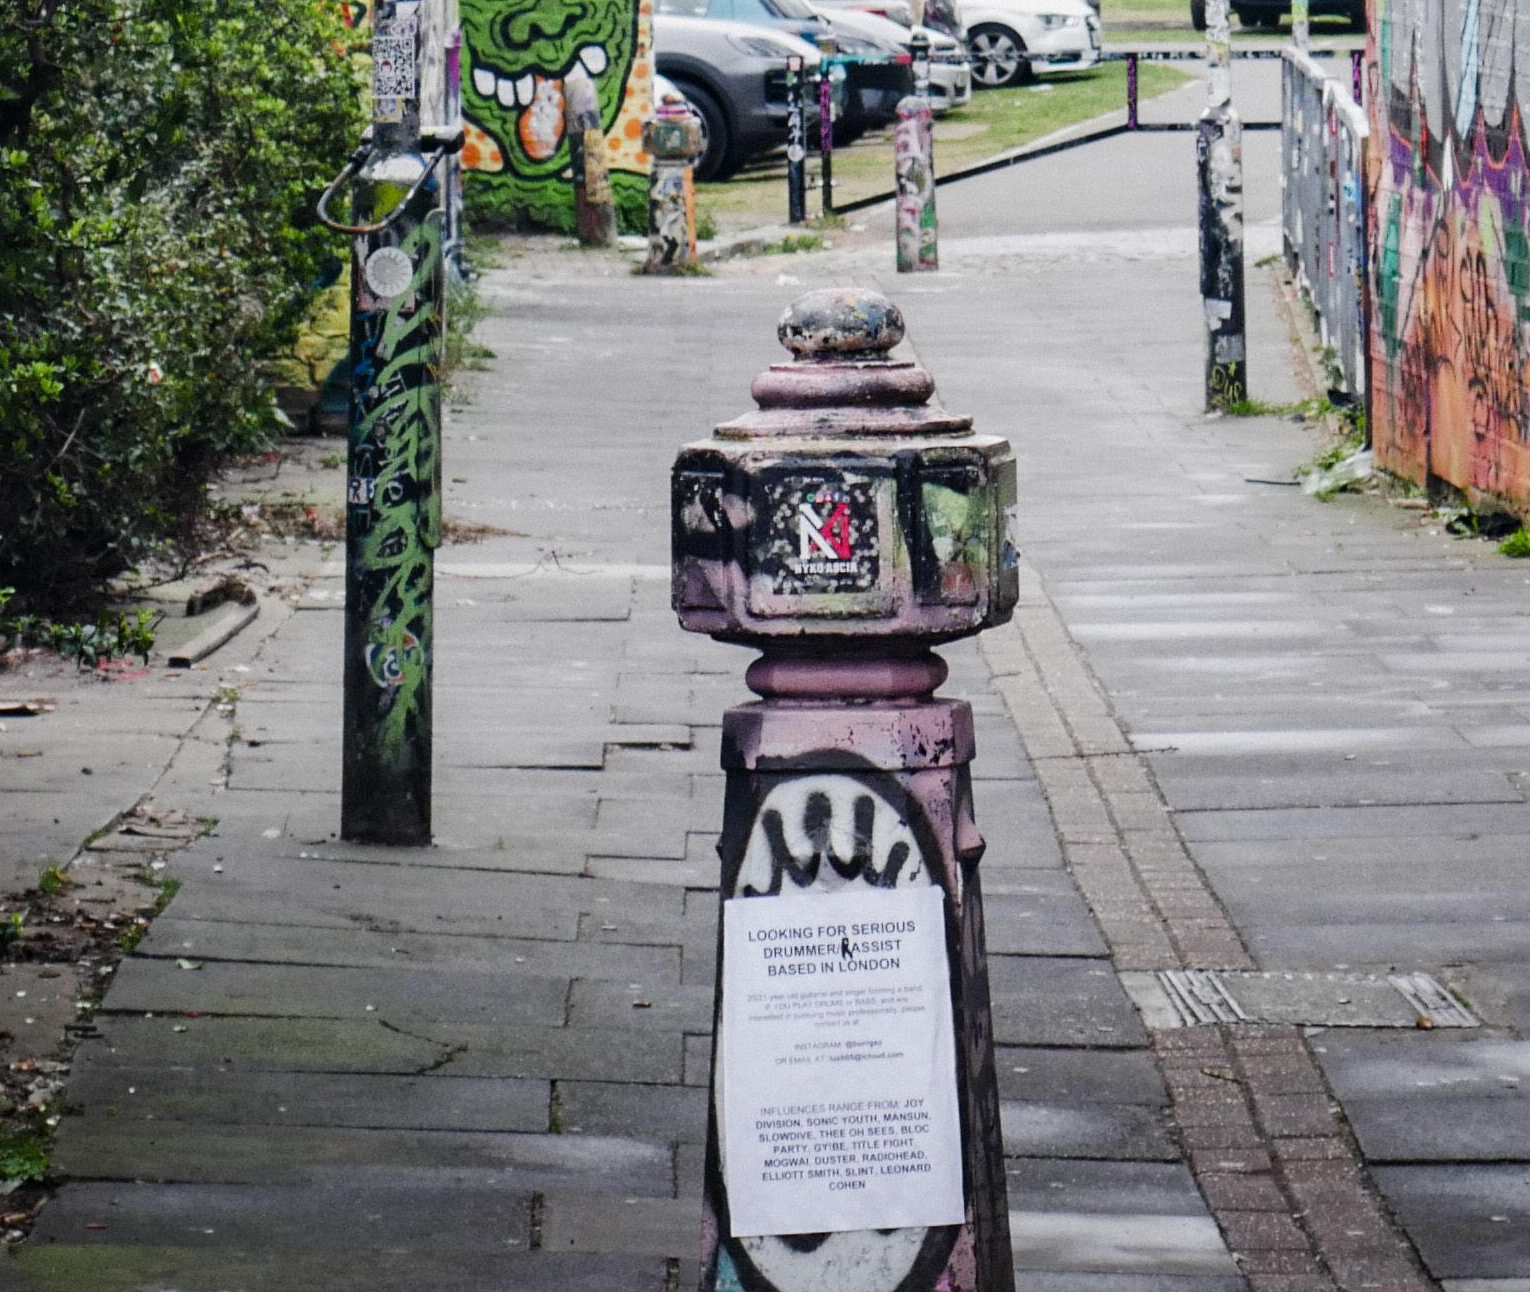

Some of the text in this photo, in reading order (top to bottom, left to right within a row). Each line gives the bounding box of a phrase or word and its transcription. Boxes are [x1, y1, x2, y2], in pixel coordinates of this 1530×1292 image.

[748, 921, 916, 942] LOOKING FOR SERIOUS
[768, 958, 900, 976] BASED IN LONDON
[761, 1104, 825, 1116] INFLUENCES
[829, 1102, 864, 1111] RANGE
[904, 1099, 924, 1108] JOY
[807, 1116, 838, 1125] SONIC
[820, 1128, 846, 1138] THEE
[849, 1127, 864, 1137] OH
[901, 1124, 929, 1134] BLOC
[852, 1140, 879, 1149] TITLE
[762, 1171, 804, 1181] ELLIOTT
[880, 1164, 931, 1175] LEONARD
[829, 1181, 865, 1190] COHEN
